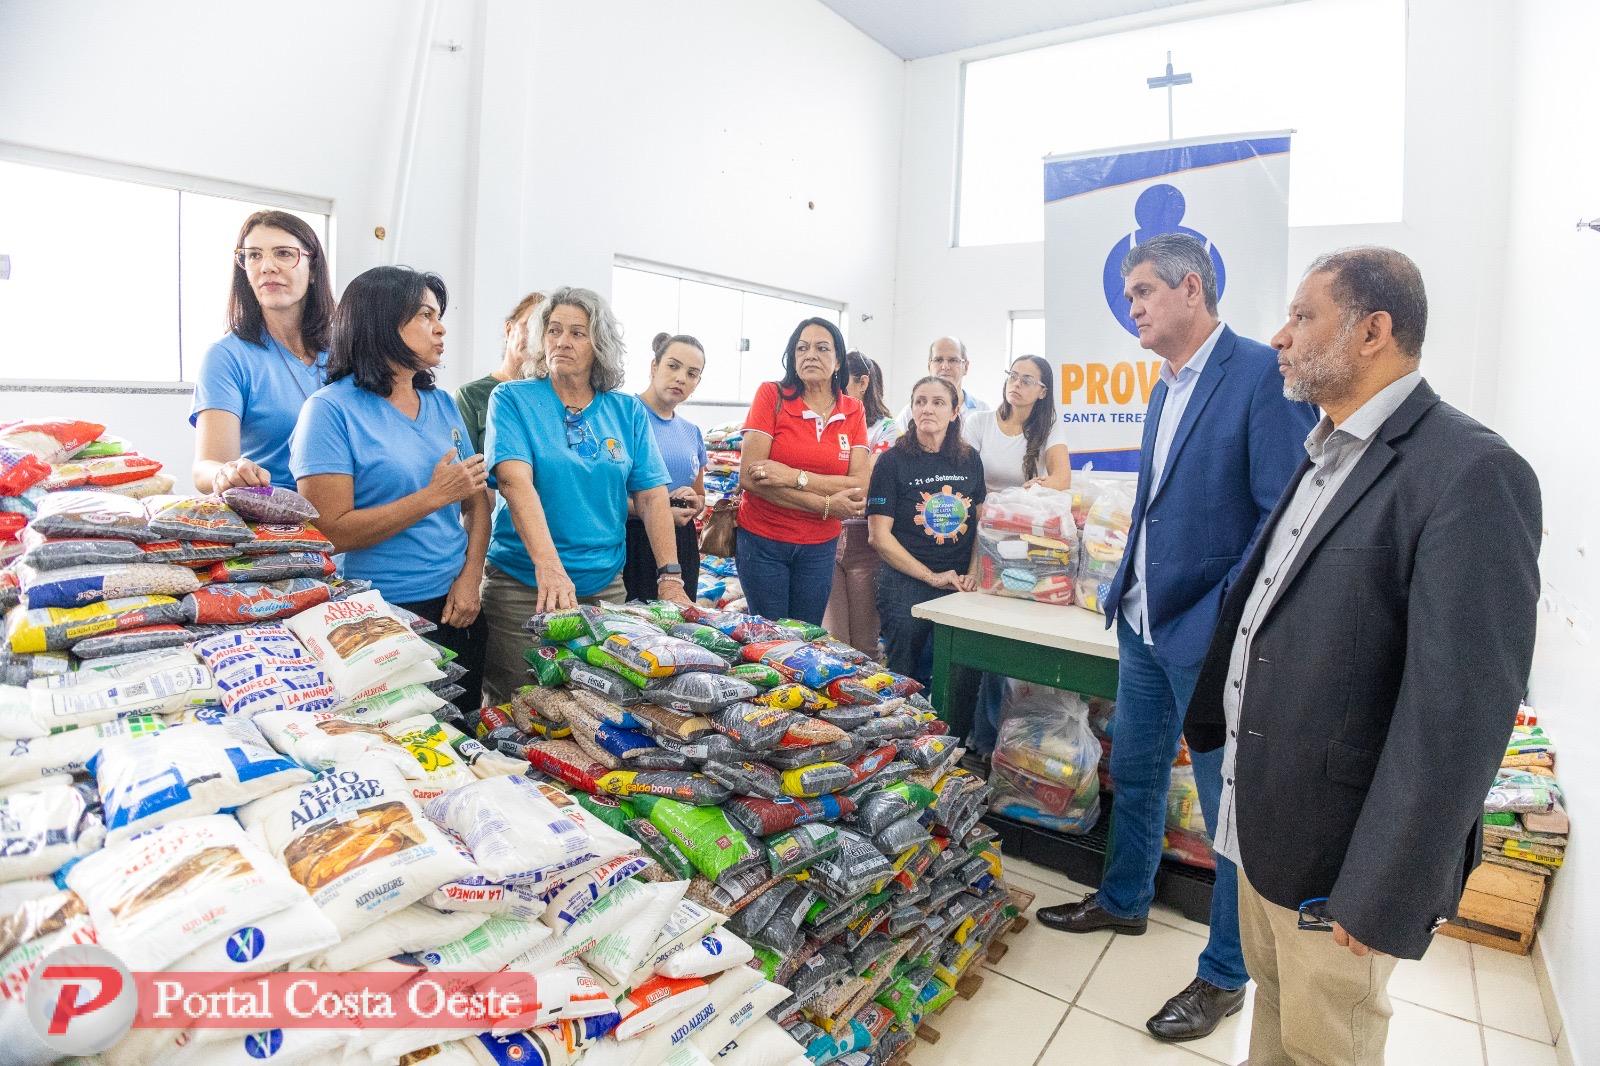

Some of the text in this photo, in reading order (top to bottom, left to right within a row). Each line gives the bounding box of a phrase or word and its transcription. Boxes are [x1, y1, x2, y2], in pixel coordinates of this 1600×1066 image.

[1063, 412, 1106, 423] SANTA
[914, 478, 923, 486] 21
[935, 474, 964, 482] Setembro
[324, 603, 376, 626] ALEGRE
[326, 601, 363, 613] ALTO
[216, 644, 257, 661] MUÑECA
[266, 655, 316, 665] LA MUÑECA
[224, 694, 235, 709] LA
[286, 692, 301, 706] LA
[299, 770, 360, 806] ALTO
[625, 783, 673, 795] caldobom
[290, 778, 385, 831] ALEGRE
[594, 865, 610, 881] LA
[355, 889, 376, 909] ALTO
[374, 877, 405, 897] ALEGRE
[488, 886, 502, 901] LA
[670, 1023, 689, 1046] ALTO
[687, 1002, 716, 1036] ALEGRE
